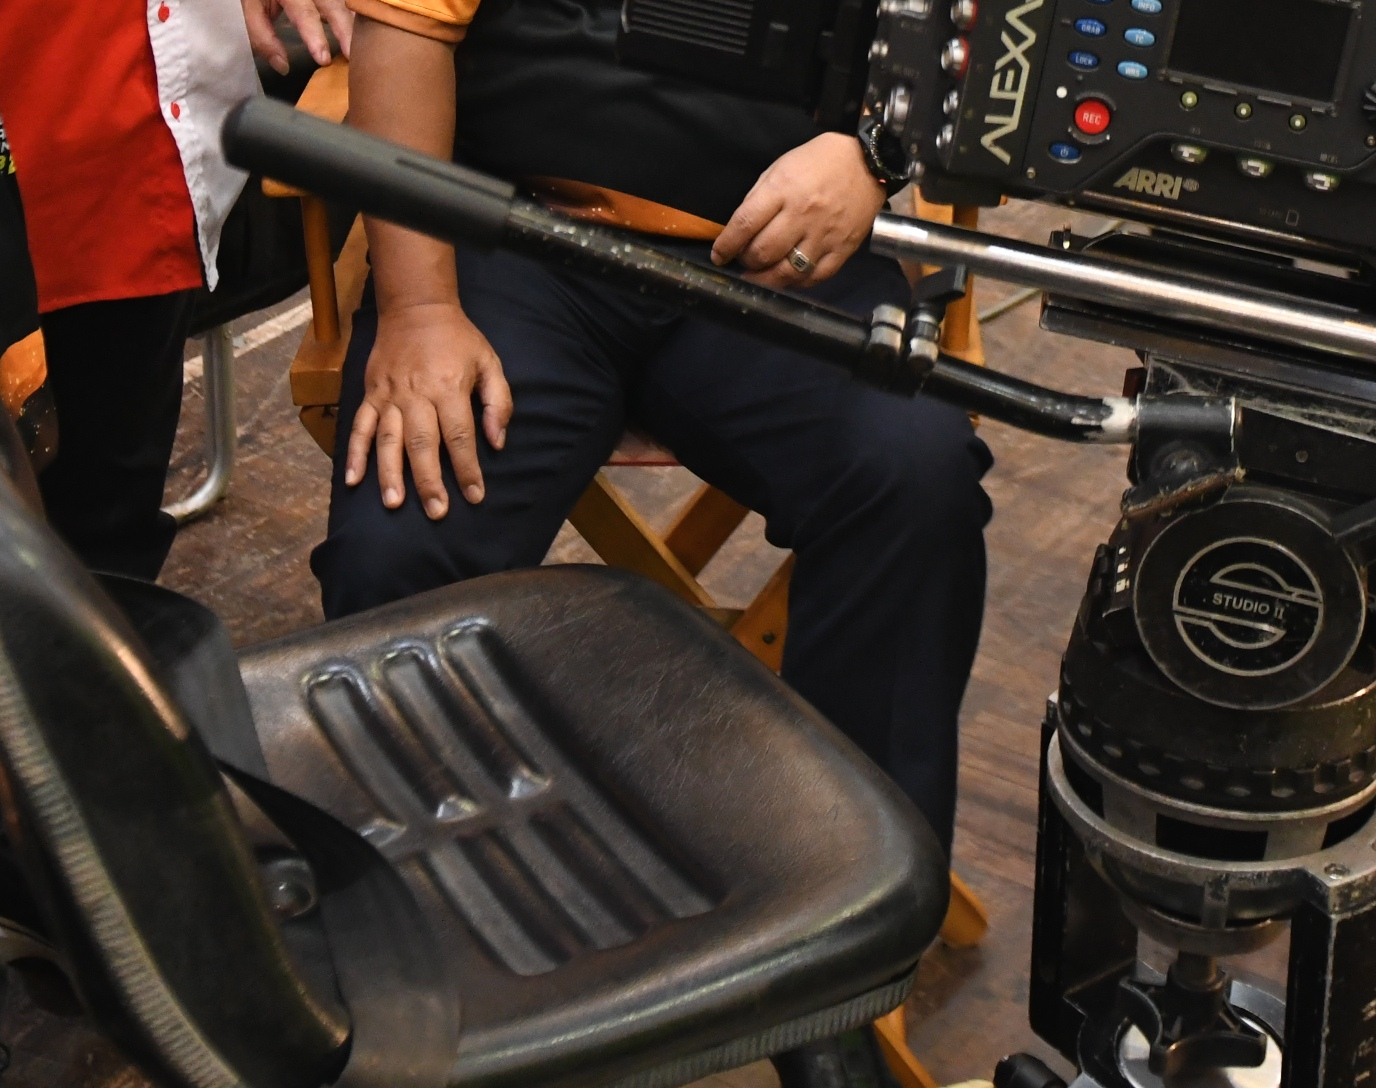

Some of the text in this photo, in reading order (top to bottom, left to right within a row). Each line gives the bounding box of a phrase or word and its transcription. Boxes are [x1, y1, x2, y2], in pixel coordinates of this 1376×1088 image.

[1138, 1, 1155, 12] INFO
[1081, 24, 1100, 35] GRAB
[1075, 54, 1093, 66] LOCK
[1082, 112, 1101, 125] REC
[1113, 166, 1183, 200] ARRI
[1212, 592, 1270, 615] STUDIO
